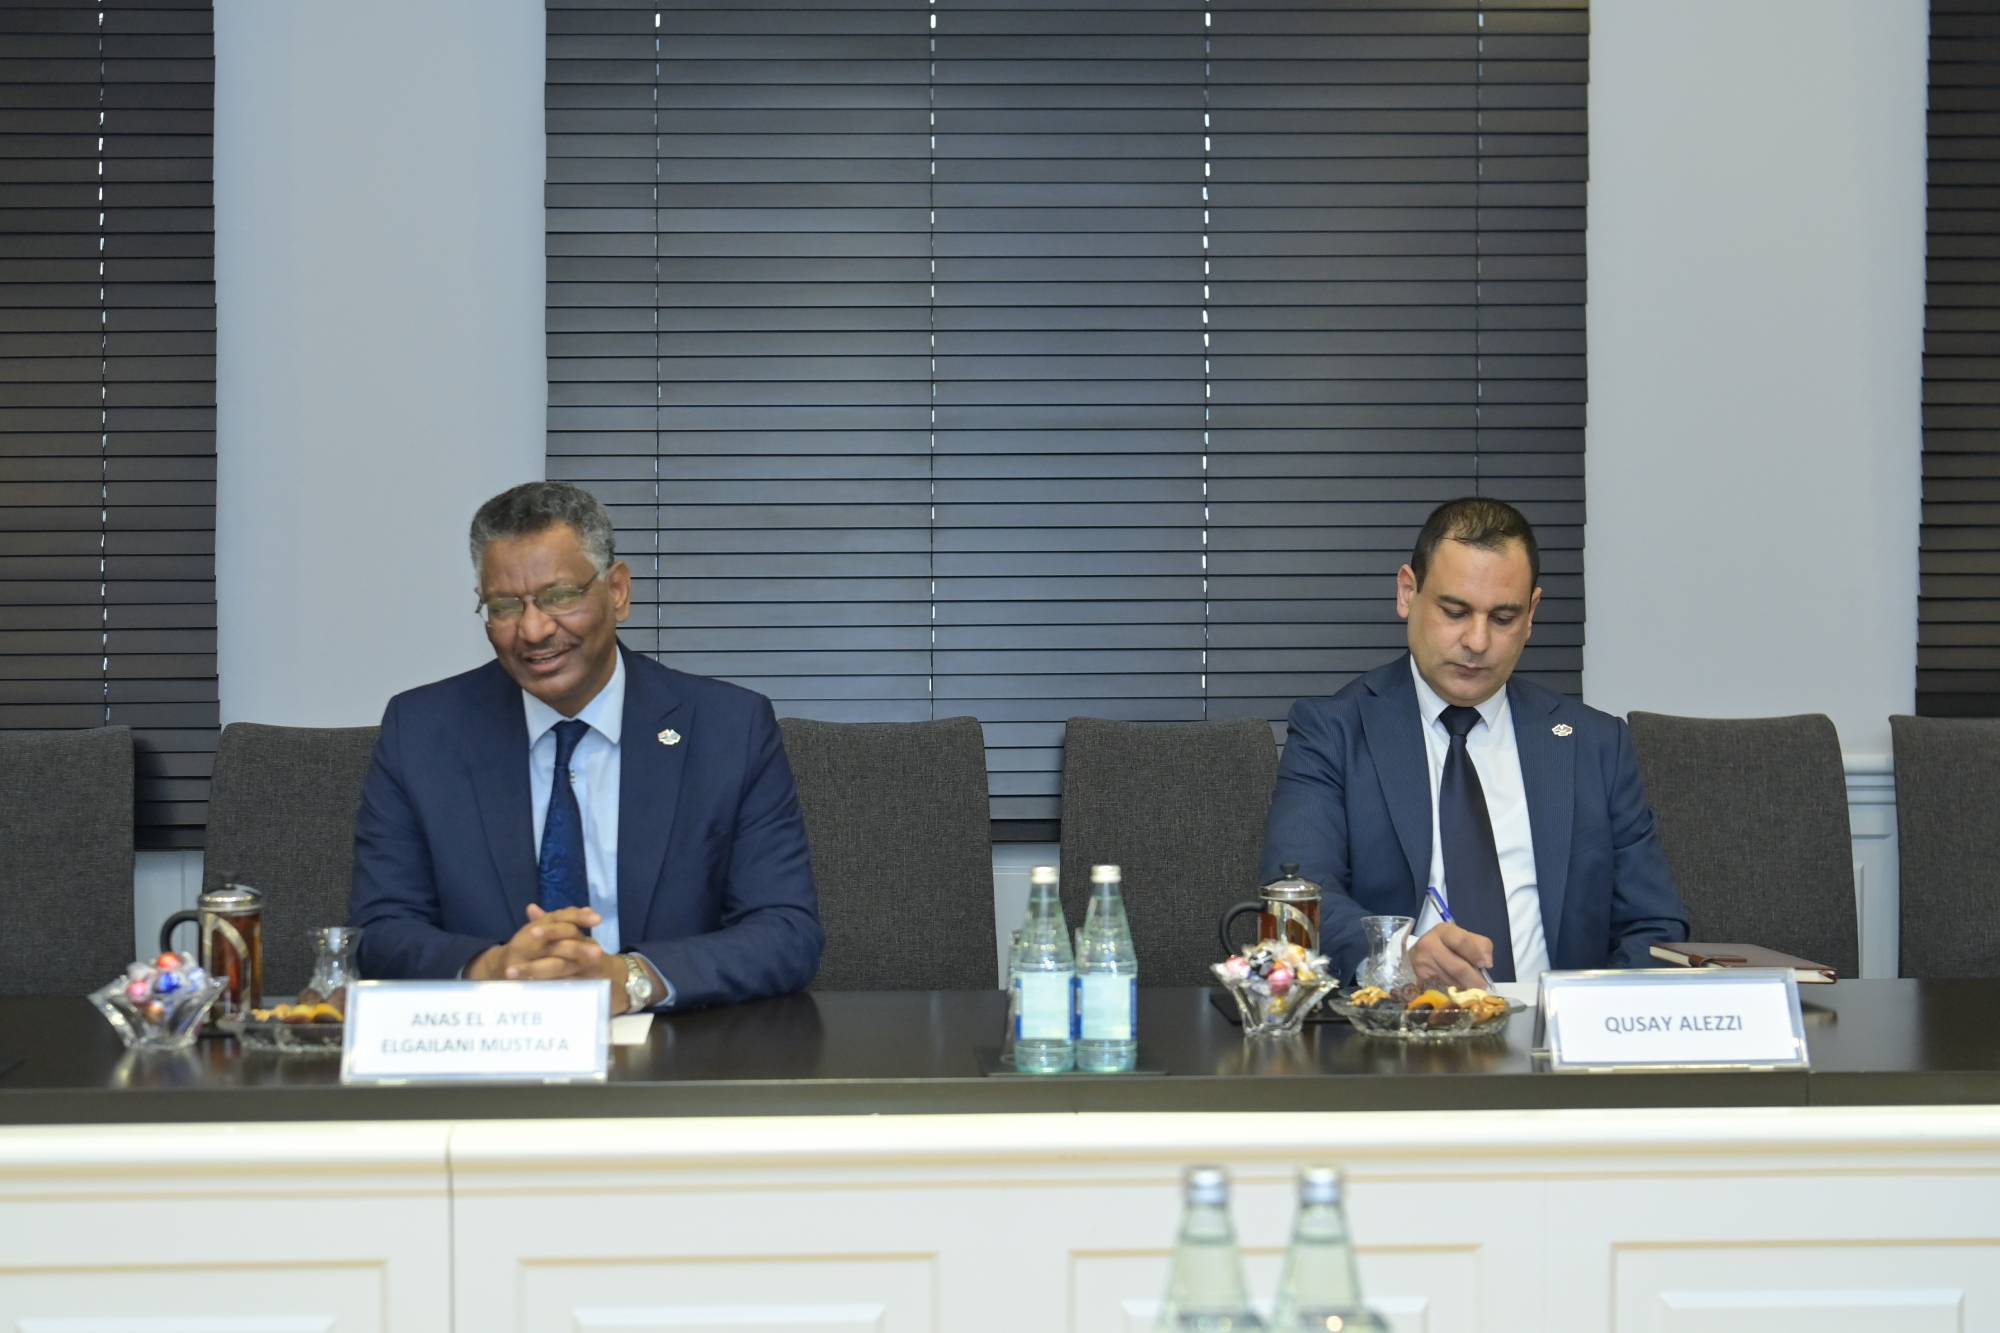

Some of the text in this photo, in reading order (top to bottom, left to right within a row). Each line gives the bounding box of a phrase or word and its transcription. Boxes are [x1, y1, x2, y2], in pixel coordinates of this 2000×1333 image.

[411, 1011, 461, 1028] ANAS
[466, 1011, 484, 1027] EL
[1605, 1015, 1743, 1034] QUSAY ALEZZI
[382, 1037, 570, 1054] ELGAILANI MUSTAFA
